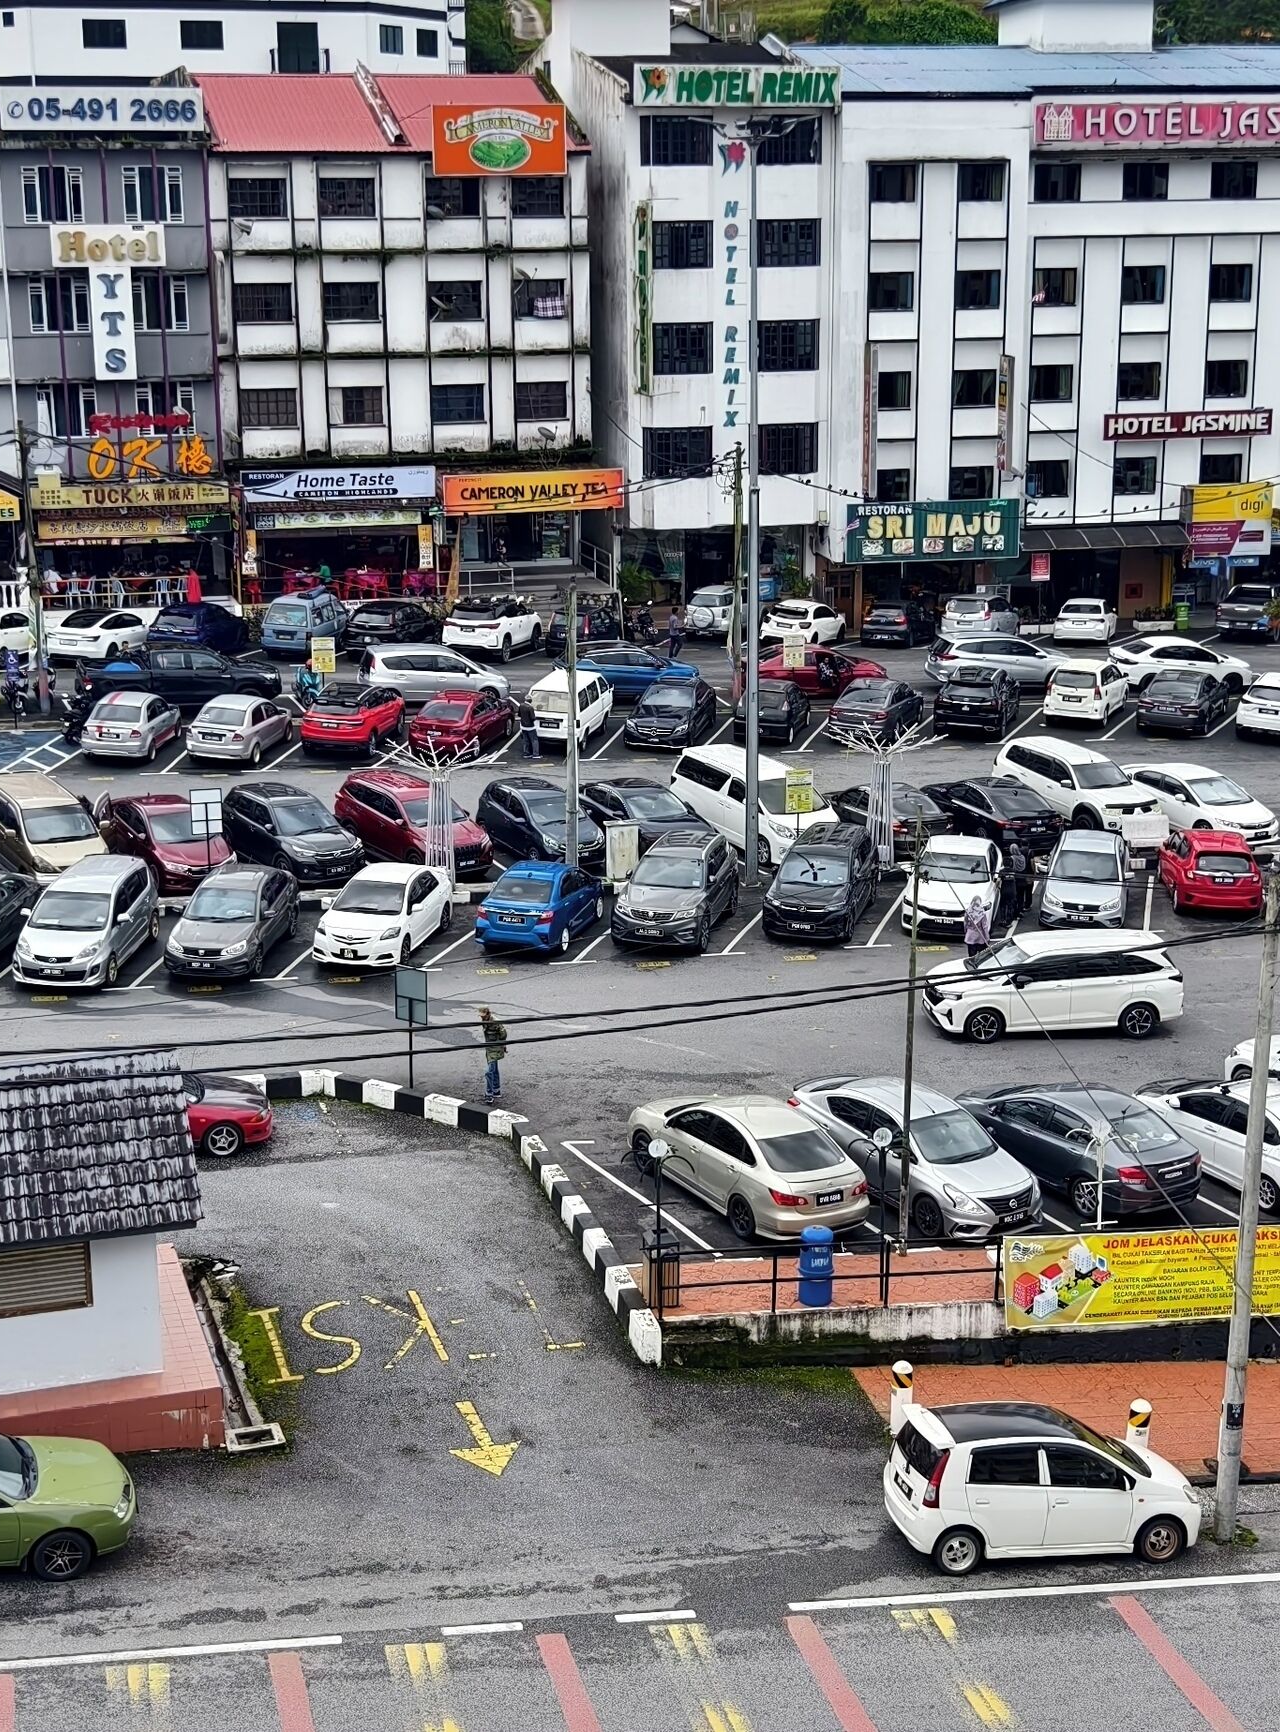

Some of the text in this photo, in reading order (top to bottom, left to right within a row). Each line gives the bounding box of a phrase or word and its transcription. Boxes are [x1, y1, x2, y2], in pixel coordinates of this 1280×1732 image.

[676, 71, 838, 103] HOTEL REMIX
[28, 98, 197, 122] 05-491 2666
[455, 118, 507, 140] CAMERON
[1084, 107, 1204, 138] HOTEL
[58, 231, 161, 263] Hotel
[723, 201, 740, 428] HOTEL REMIX
[1108, 413, 1270, 438] HOTEL JASMINE
[88, 437, 162, 479] OK
[297, 474, 346, 488] Home
[350, 472, 395, 487] Taste
[461, 482, 609, 501] CAMERON VALLEY TEA
[82, 489, 134, 505] TUCK
[345, 488, 394, 496] HIGHLANDS
[858, 505, 913, 516] RESTORAN
[1240, 499, 1264, 513] digi
[866, 511, 1001, 539] SRI MAJU
[1103, 1238, 1130, 1249] JOM
[1133, 1234, 1199, 1248] JELASKAN
[1203, 1233, 1237, 1244] CUKA
